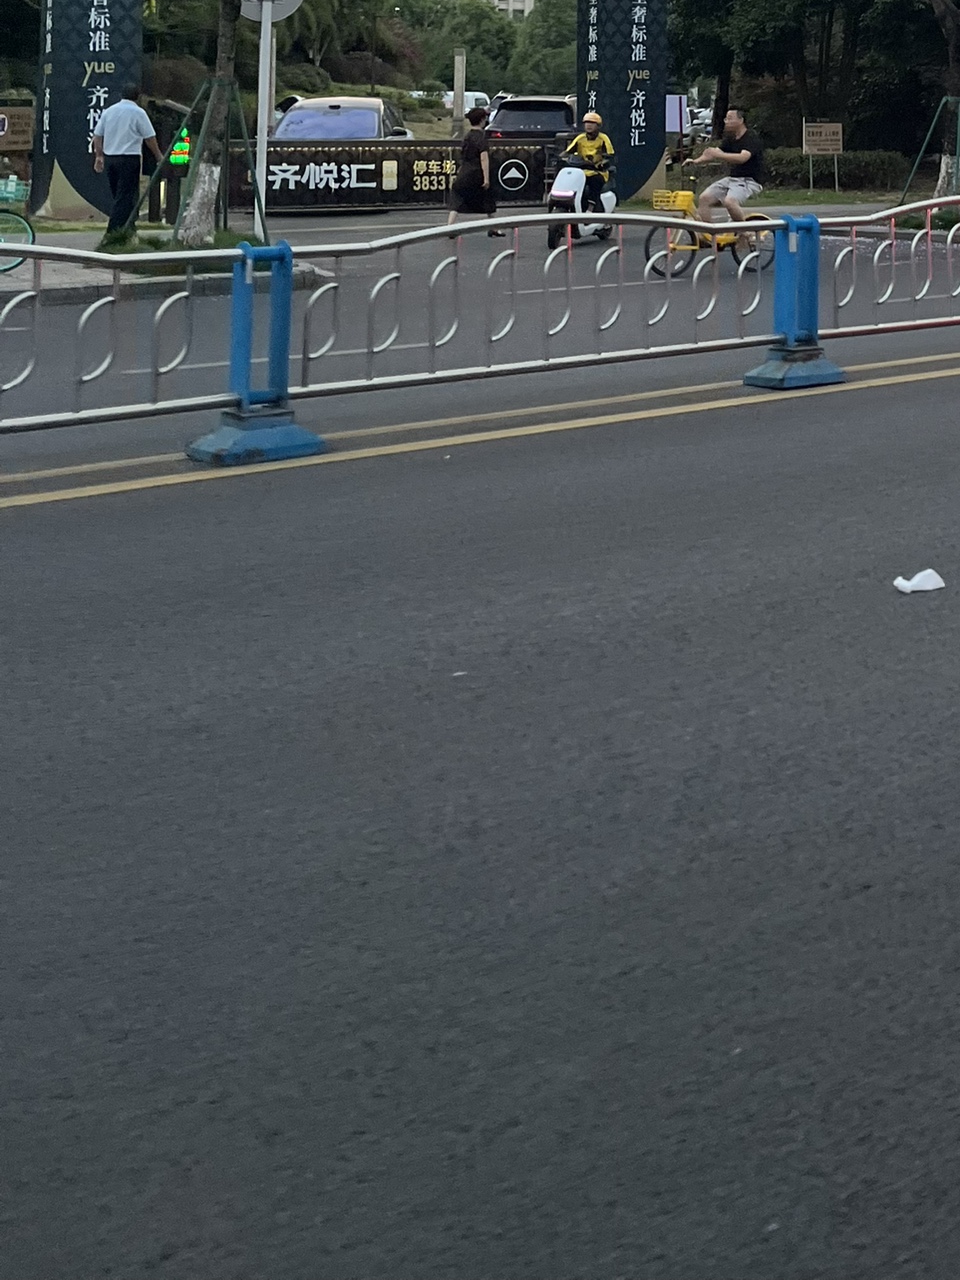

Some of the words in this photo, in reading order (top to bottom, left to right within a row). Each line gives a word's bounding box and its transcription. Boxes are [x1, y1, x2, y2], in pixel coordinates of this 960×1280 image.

[82, 60, 116, 88] yue
[626, 69, 650, 91] yue
[630, 89, 647, 147] 齐悦汇
[267, 162, 377, 191] 齐悦汇
